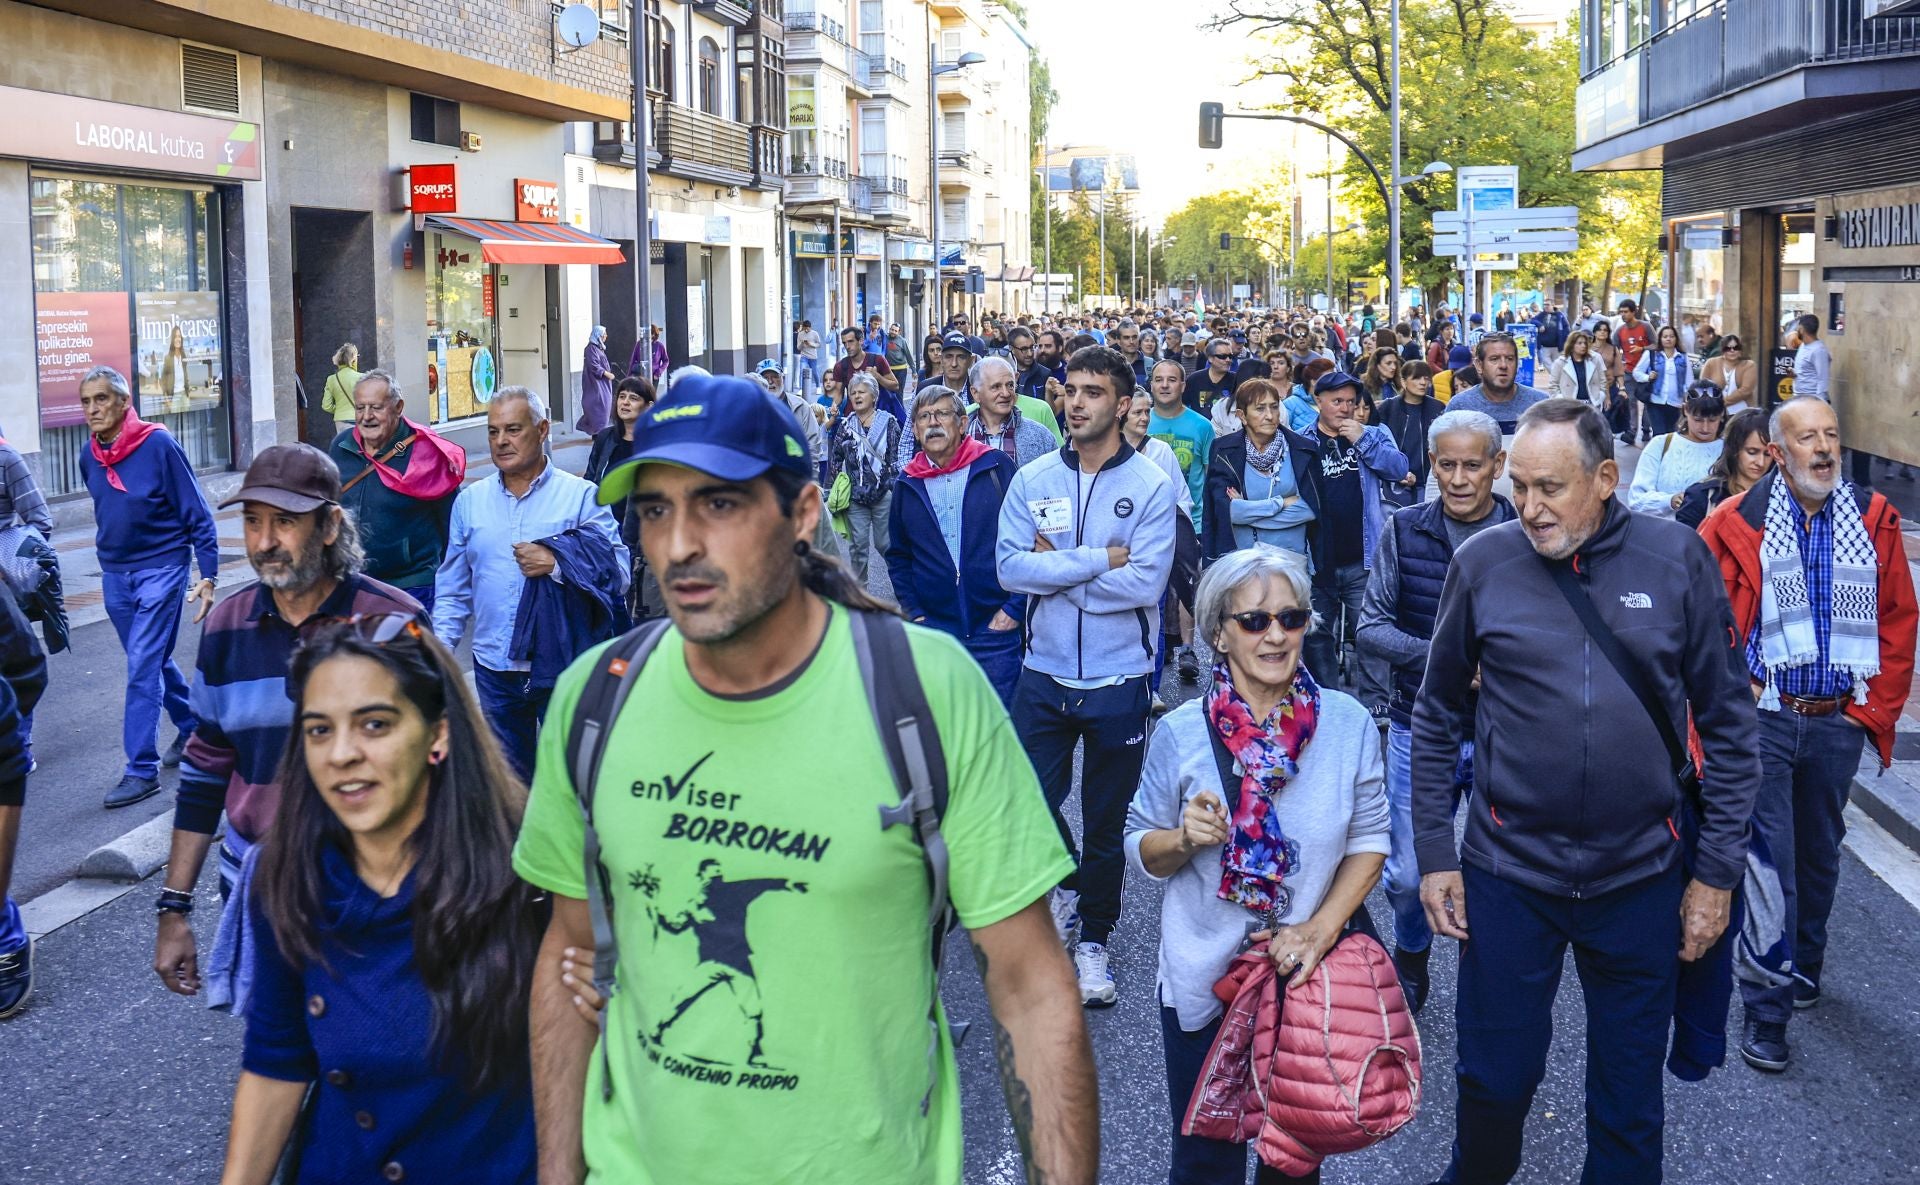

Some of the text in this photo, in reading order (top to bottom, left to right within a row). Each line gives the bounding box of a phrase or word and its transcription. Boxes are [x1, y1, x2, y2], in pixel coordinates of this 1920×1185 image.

[75, 121, 204, 160] LABORAL kutxa
[413, 184, 453, 195] SQRUPS
[1901, 266, 1912, 280] LA
[141, 313, 217, 345] Implicarse
[38, 335, 93, 352] nplikatzeko
[64, 350, 93, 367] ginen.
[662, 812, 831, 862] BORROKAN
[663, 1055, 733, 1086] CONVENIO
[736, 1072, 799, 1091] PROPIO
